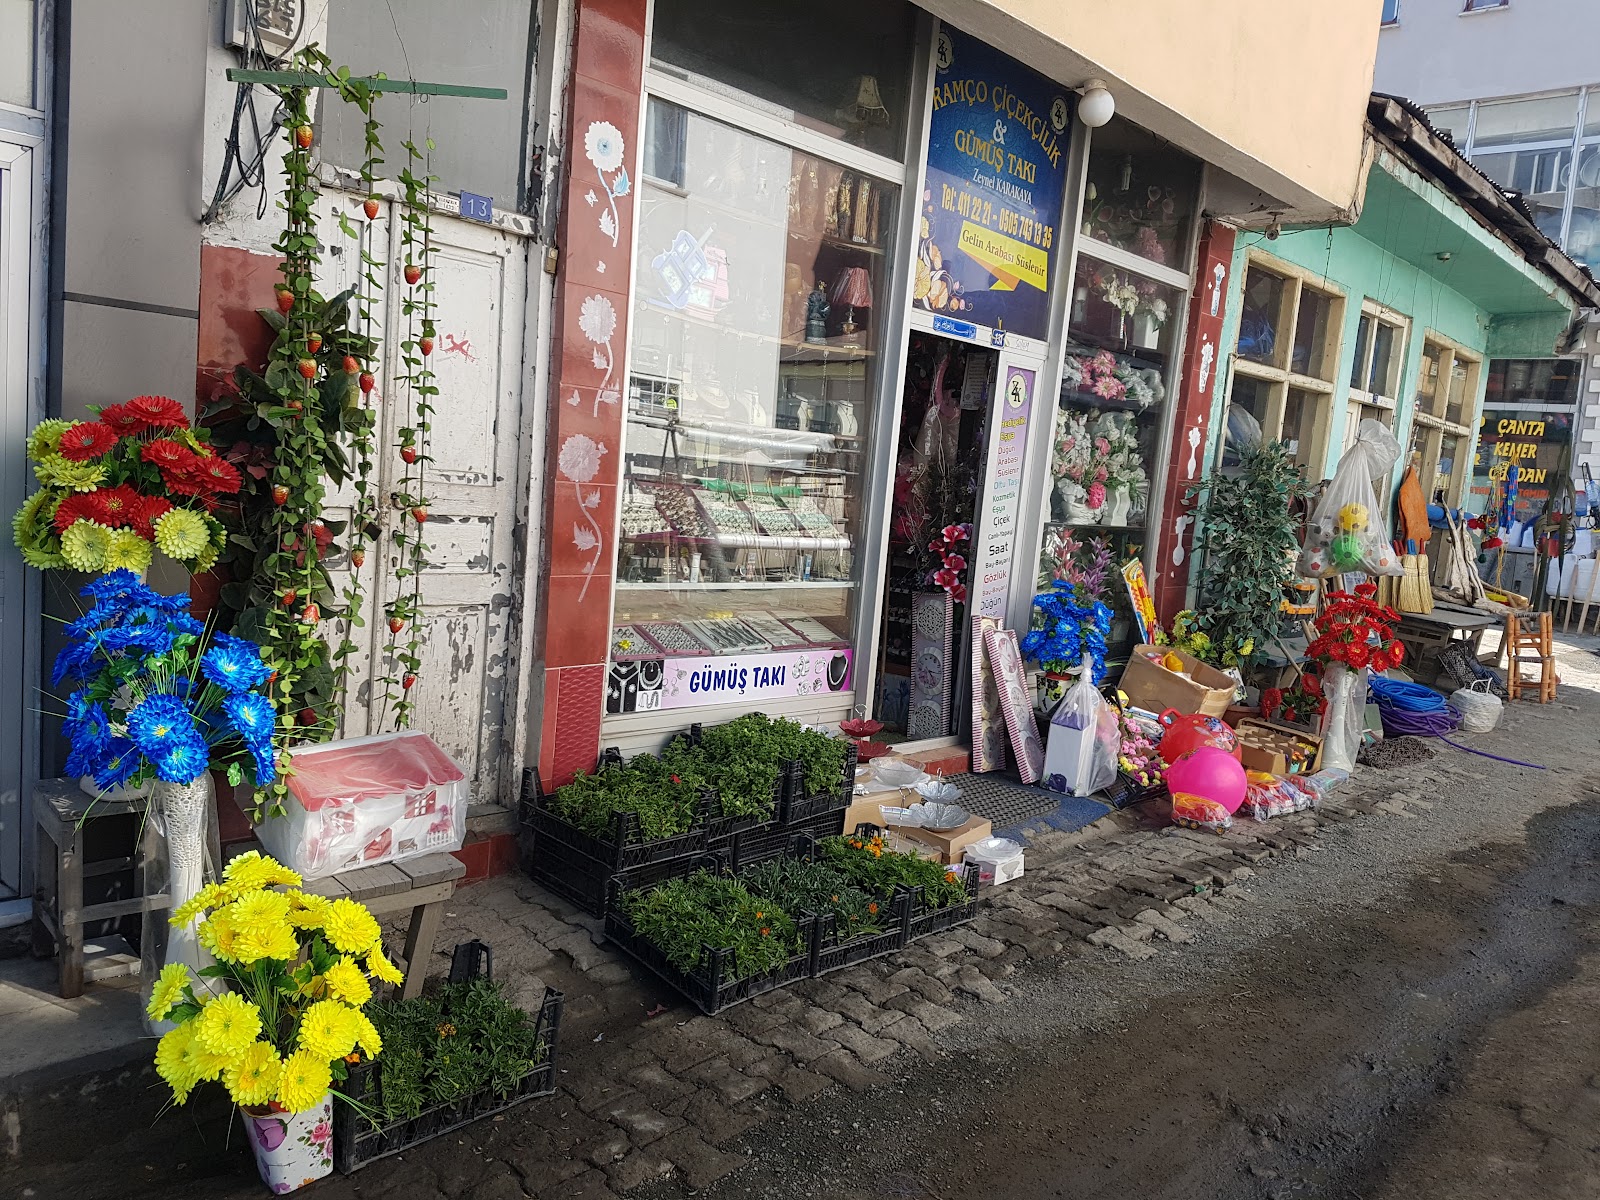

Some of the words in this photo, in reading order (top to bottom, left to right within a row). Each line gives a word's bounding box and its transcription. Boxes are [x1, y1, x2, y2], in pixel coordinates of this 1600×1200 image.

[933, 80, 988, 111] RAMÇO
[992, 84, 1062, 169] ÇİÇEKÇİLİK
[993, 119, 1007, 145] &
[955, 129, 1004, 173] GÜMÜŞ
[1007, 153, 1037, 184] TAKI
[972, 168, 995, 189] Zeynel
[996, 178, 1032, 205] KARAKAYA
[467, 198, 487, 217] 13
[941, 183, 957, 212] Tel:
[971, 196, 982, 221] 22
[982, 201, 992, 225] 21
[999, 207, 1019, 236] 0505
[1034, 222, 1043, 245] 13
[962, 229, 984, 249] Gelin
[985, 241, 1014, 263] Arabası
[1015, 253, 1045, 277] Süslenir
[1497, 418, 1545, 438] ÇANTA
[1493, 441, 1537, 459] KEMER
[993, 514, 1011, 528] Çiçek
[988, 541, 1009, 556] Saat
[983, 569, 1007, 584] Gözlük
[689, 662, 748, 695] GÜMÜŞ
[753, 665, 786, 689] TAKI
